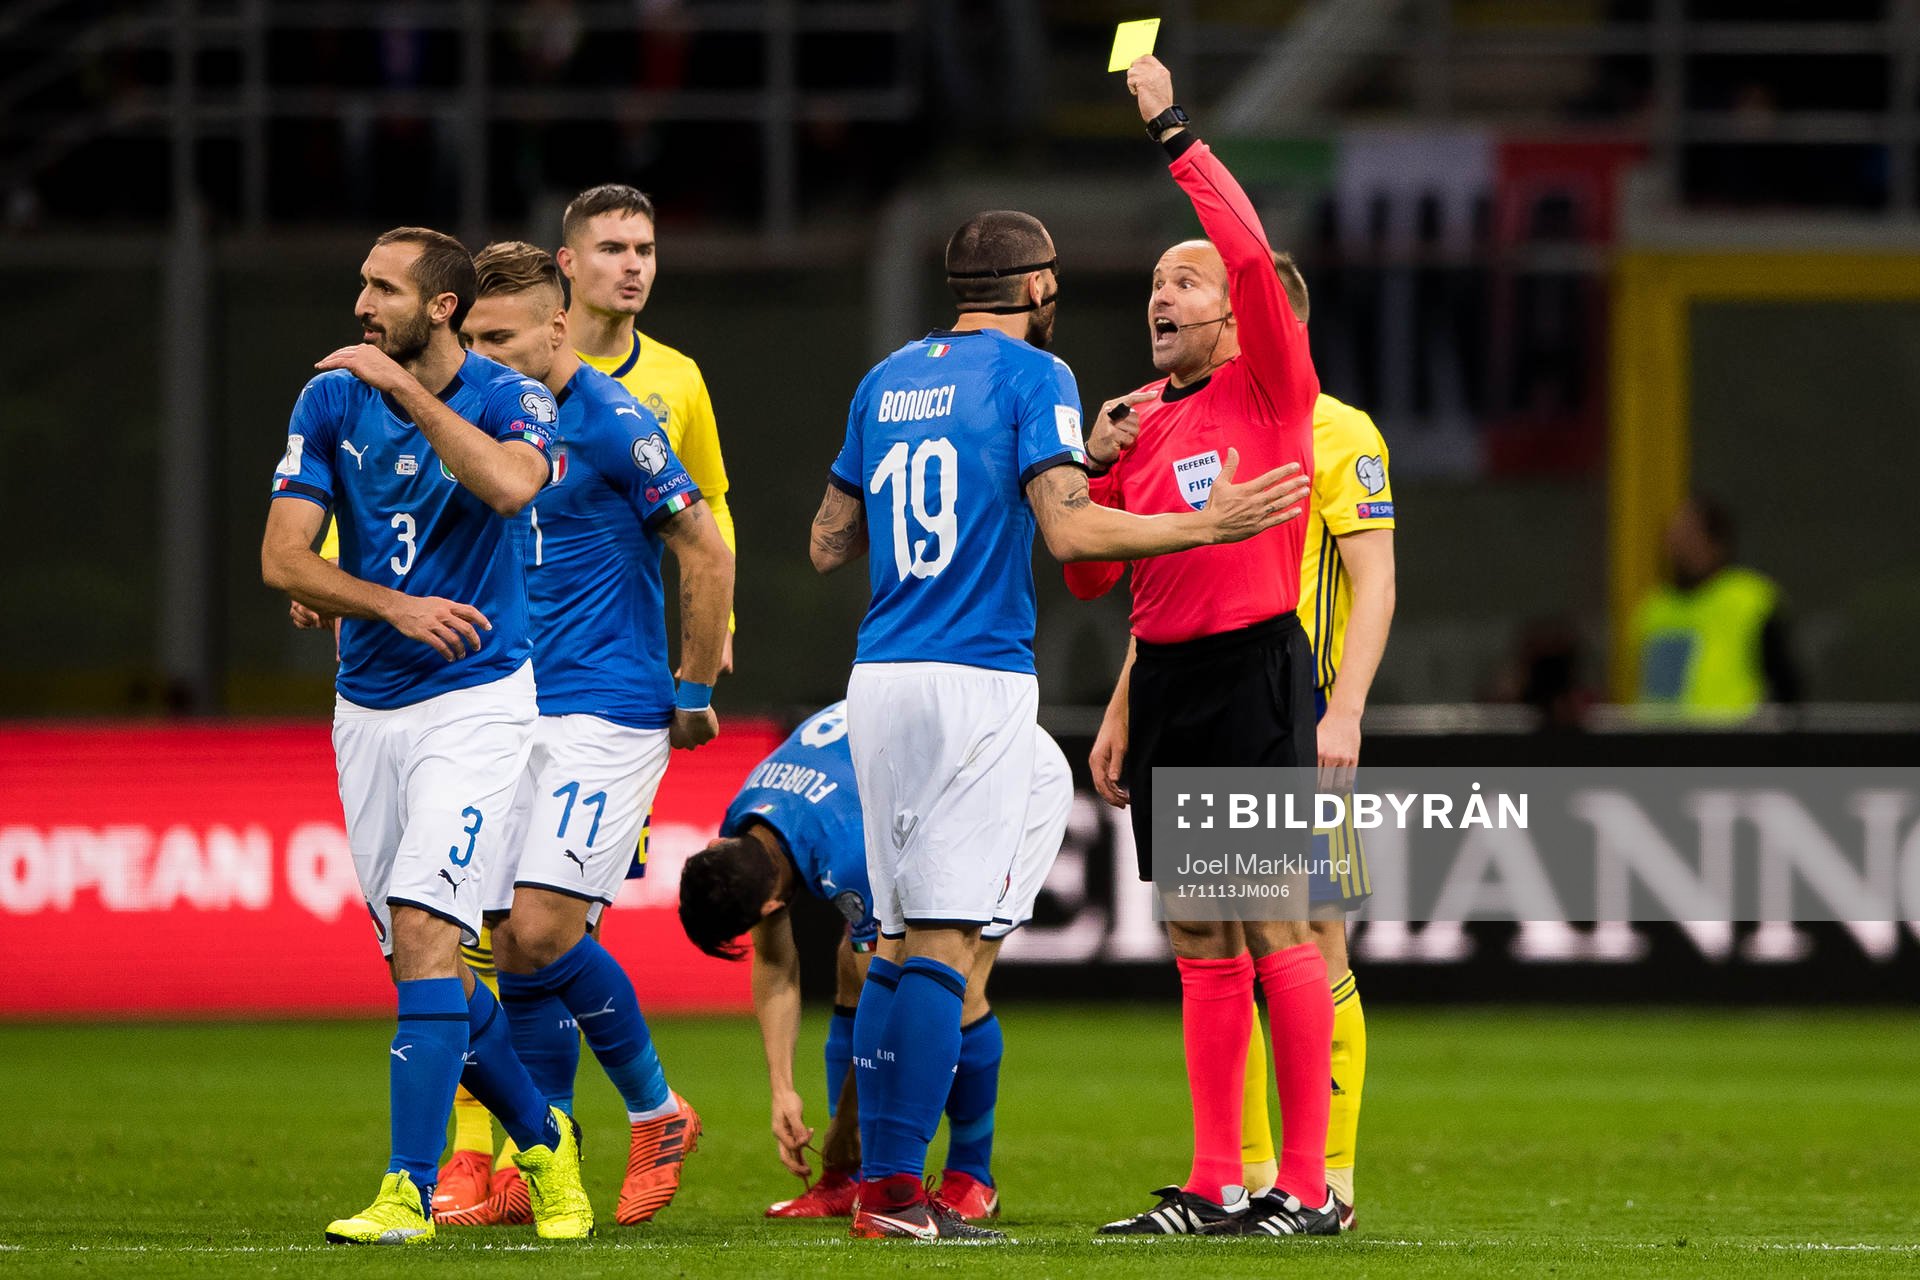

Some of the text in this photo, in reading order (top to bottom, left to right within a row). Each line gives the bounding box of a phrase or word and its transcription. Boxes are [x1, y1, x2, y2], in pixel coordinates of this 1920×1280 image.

[878, 385, 956, 423] BONUCCI
[1177, 455, 1216, 472] REFEREE
[870, 437, 958, 582] 19
[391, 513, 416, 576] 3
[449, 806, 483, 868] 3
[553, 781, 607, 848] 11
